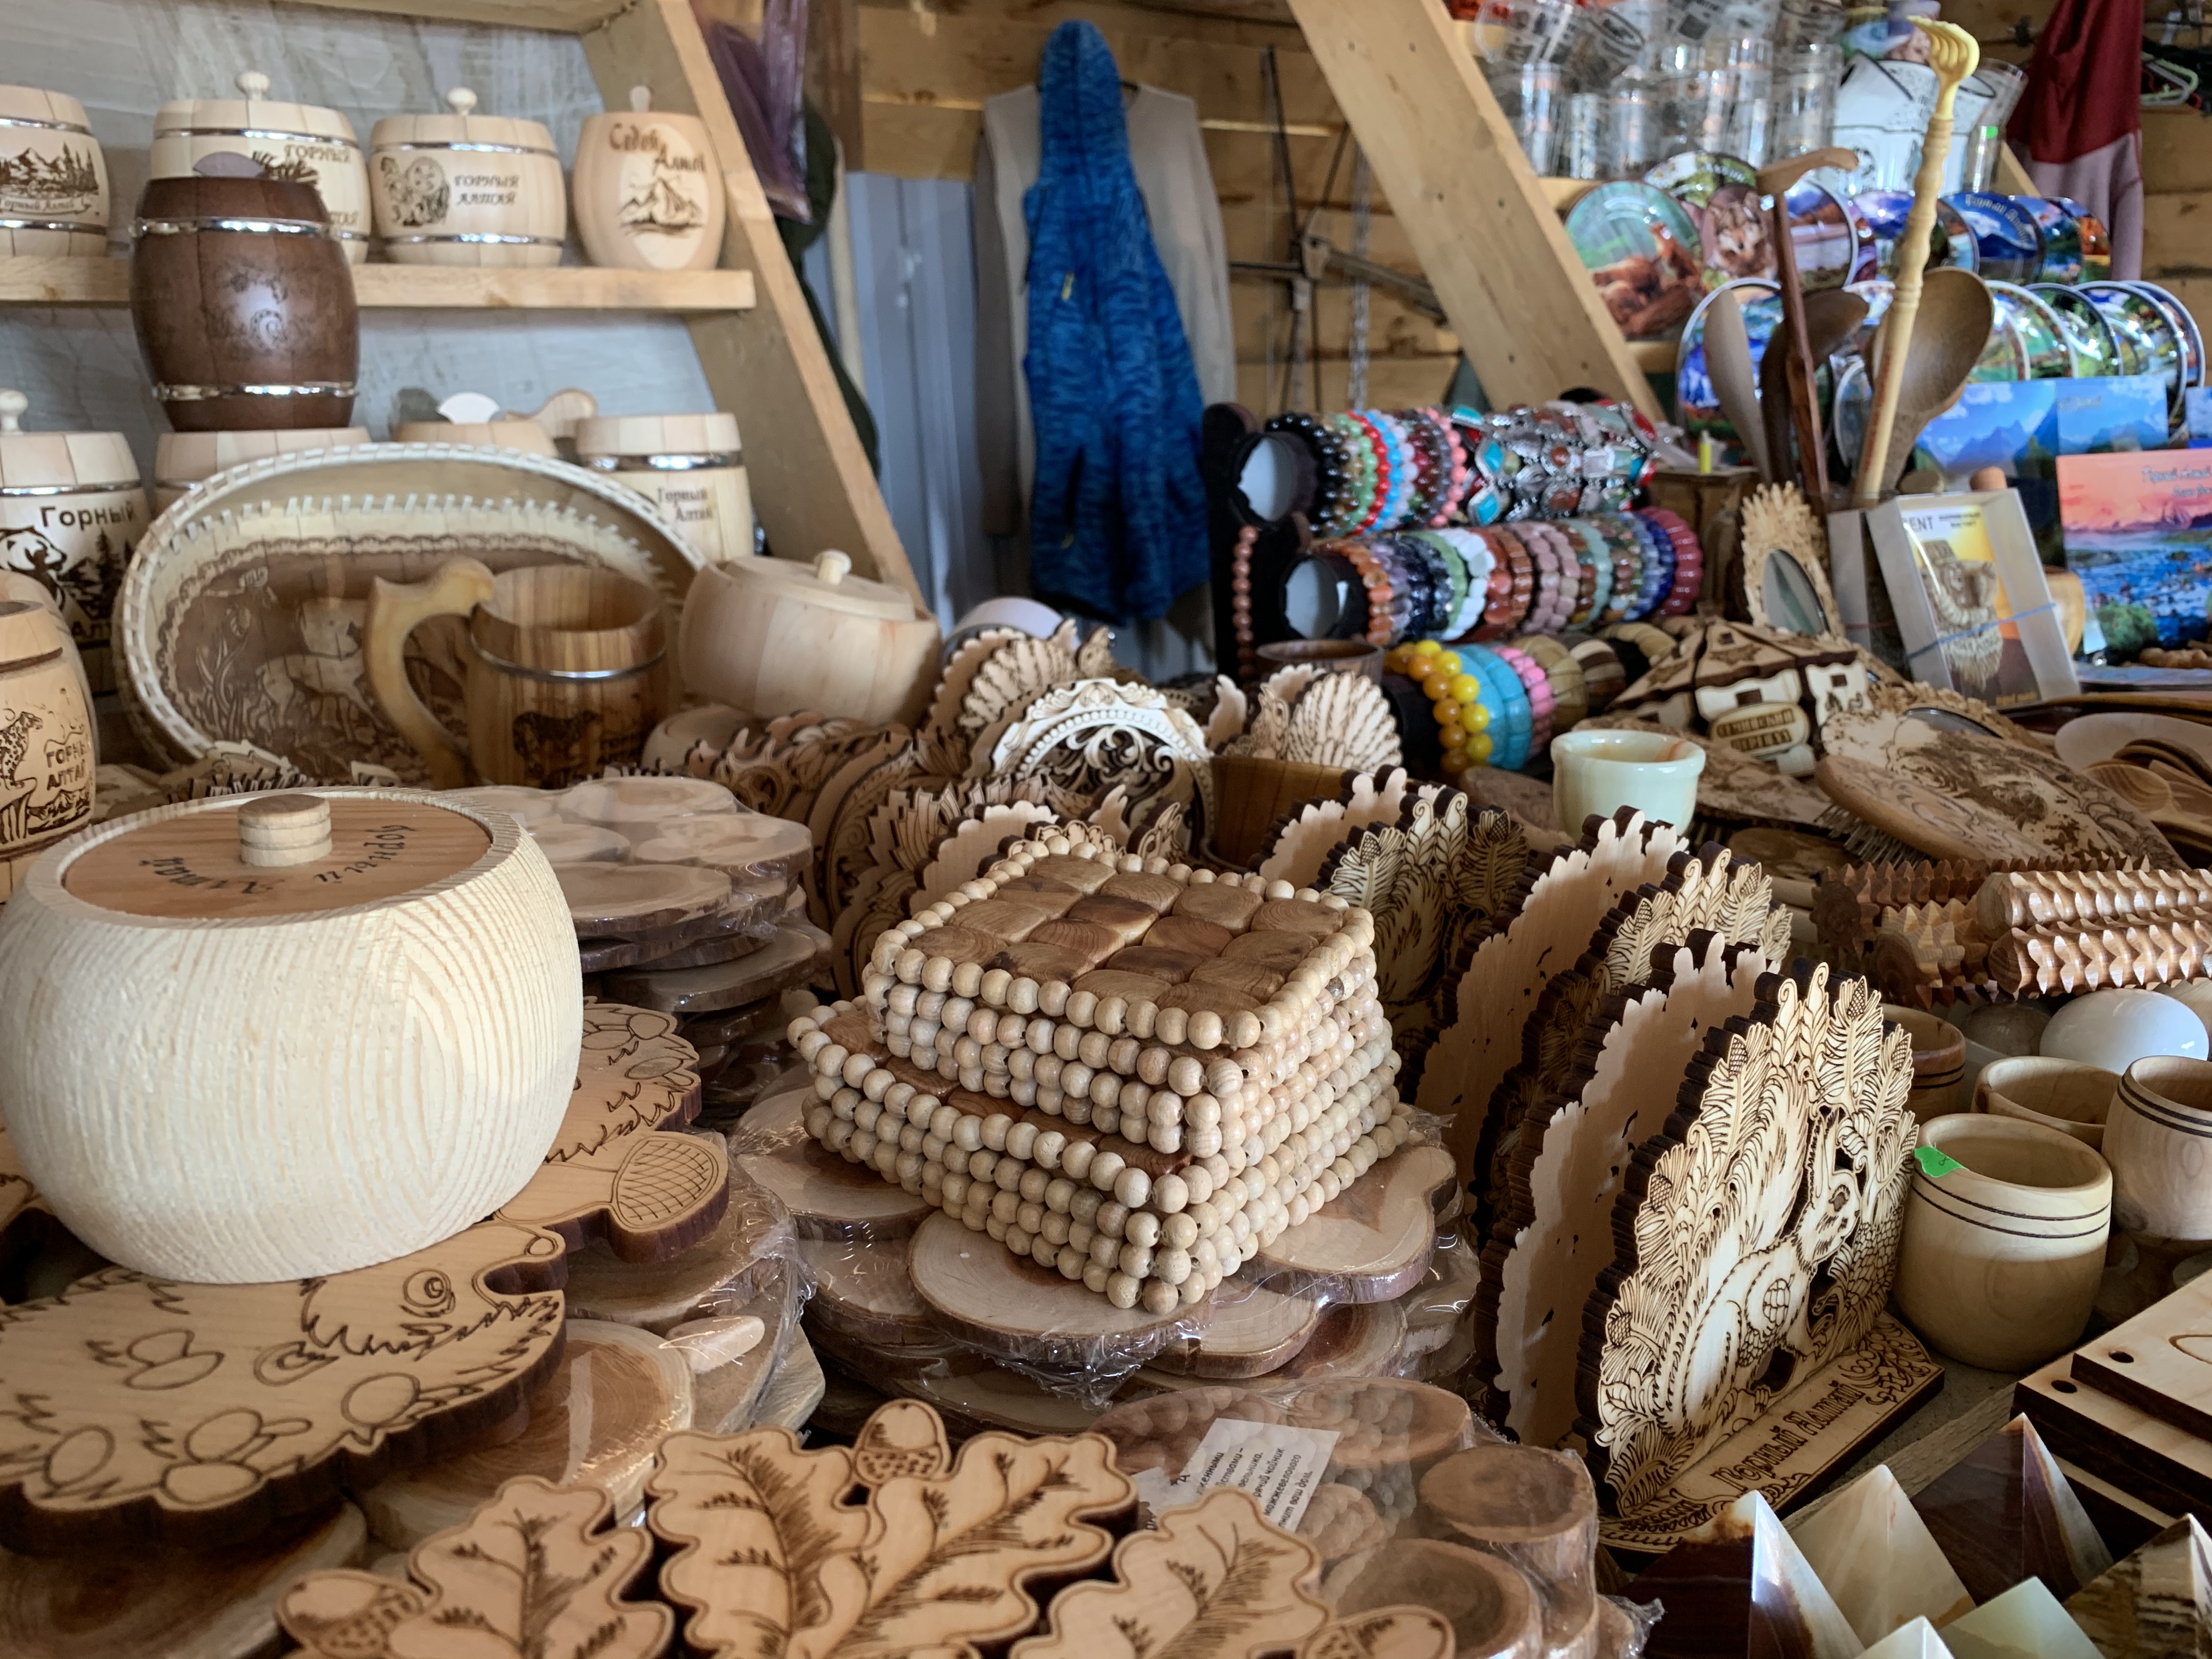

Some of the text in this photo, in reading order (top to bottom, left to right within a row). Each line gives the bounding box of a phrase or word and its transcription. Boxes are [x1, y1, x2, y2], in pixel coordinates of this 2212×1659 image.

[40, 501, 135, 531] Горный
[1710, 1380, 1865, 1491] Горный Алтай
